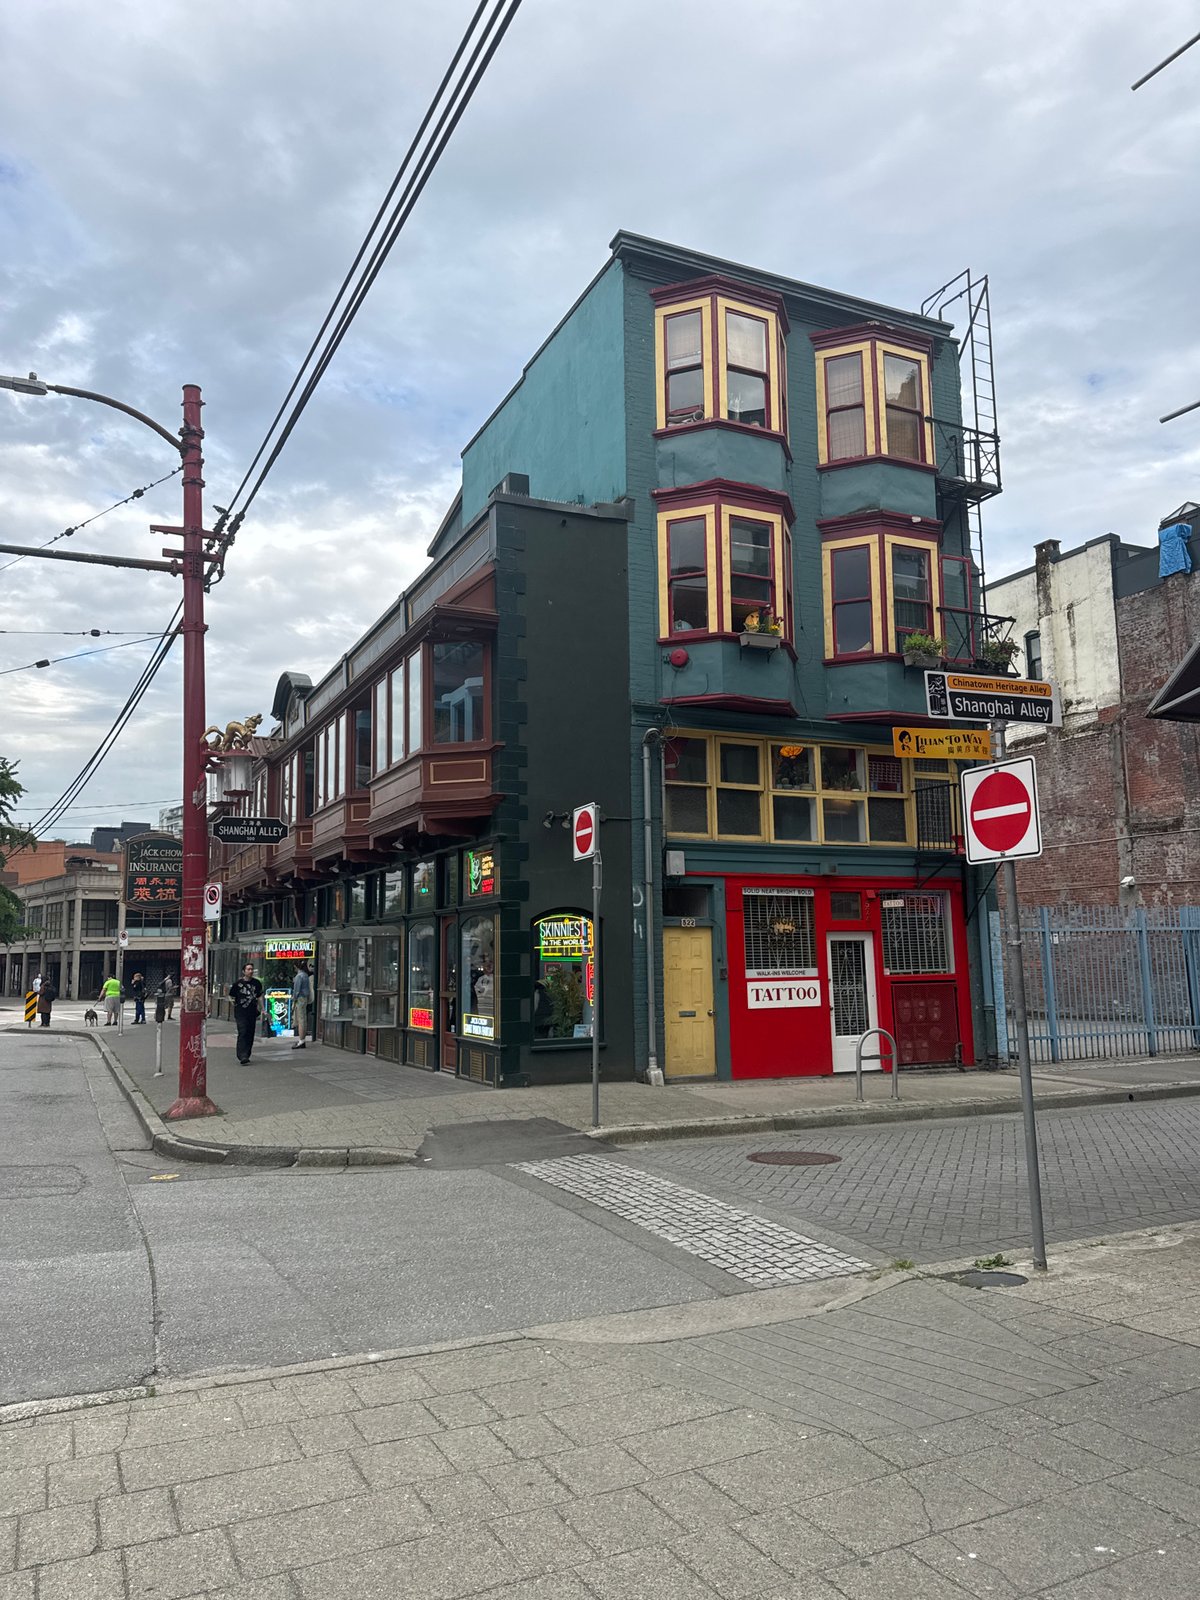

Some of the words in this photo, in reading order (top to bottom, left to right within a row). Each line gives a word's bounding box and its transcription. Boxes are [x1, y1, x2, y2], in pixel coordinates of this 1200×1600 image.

[952, 677, 994, 690] Chinatown
[995, 683, 1028, 694] Heritage
[1029, 686, 1048, 696] Alley
[955, 697, 1015, 717] Shanghai
[1019, 701, 1050, 721] Alley
[218, 825, 257, 836] SHANGHAI
[258, 827, 284, 837] ALLEY
[139, 848, 160, 858] JACK
[160, 849, 184, 858] CHOW
[129, 862, 184, 873] INSURANCE
[563, 938, 585, 946] WORLD
[750, 986, 818, 1002] TATTOO
